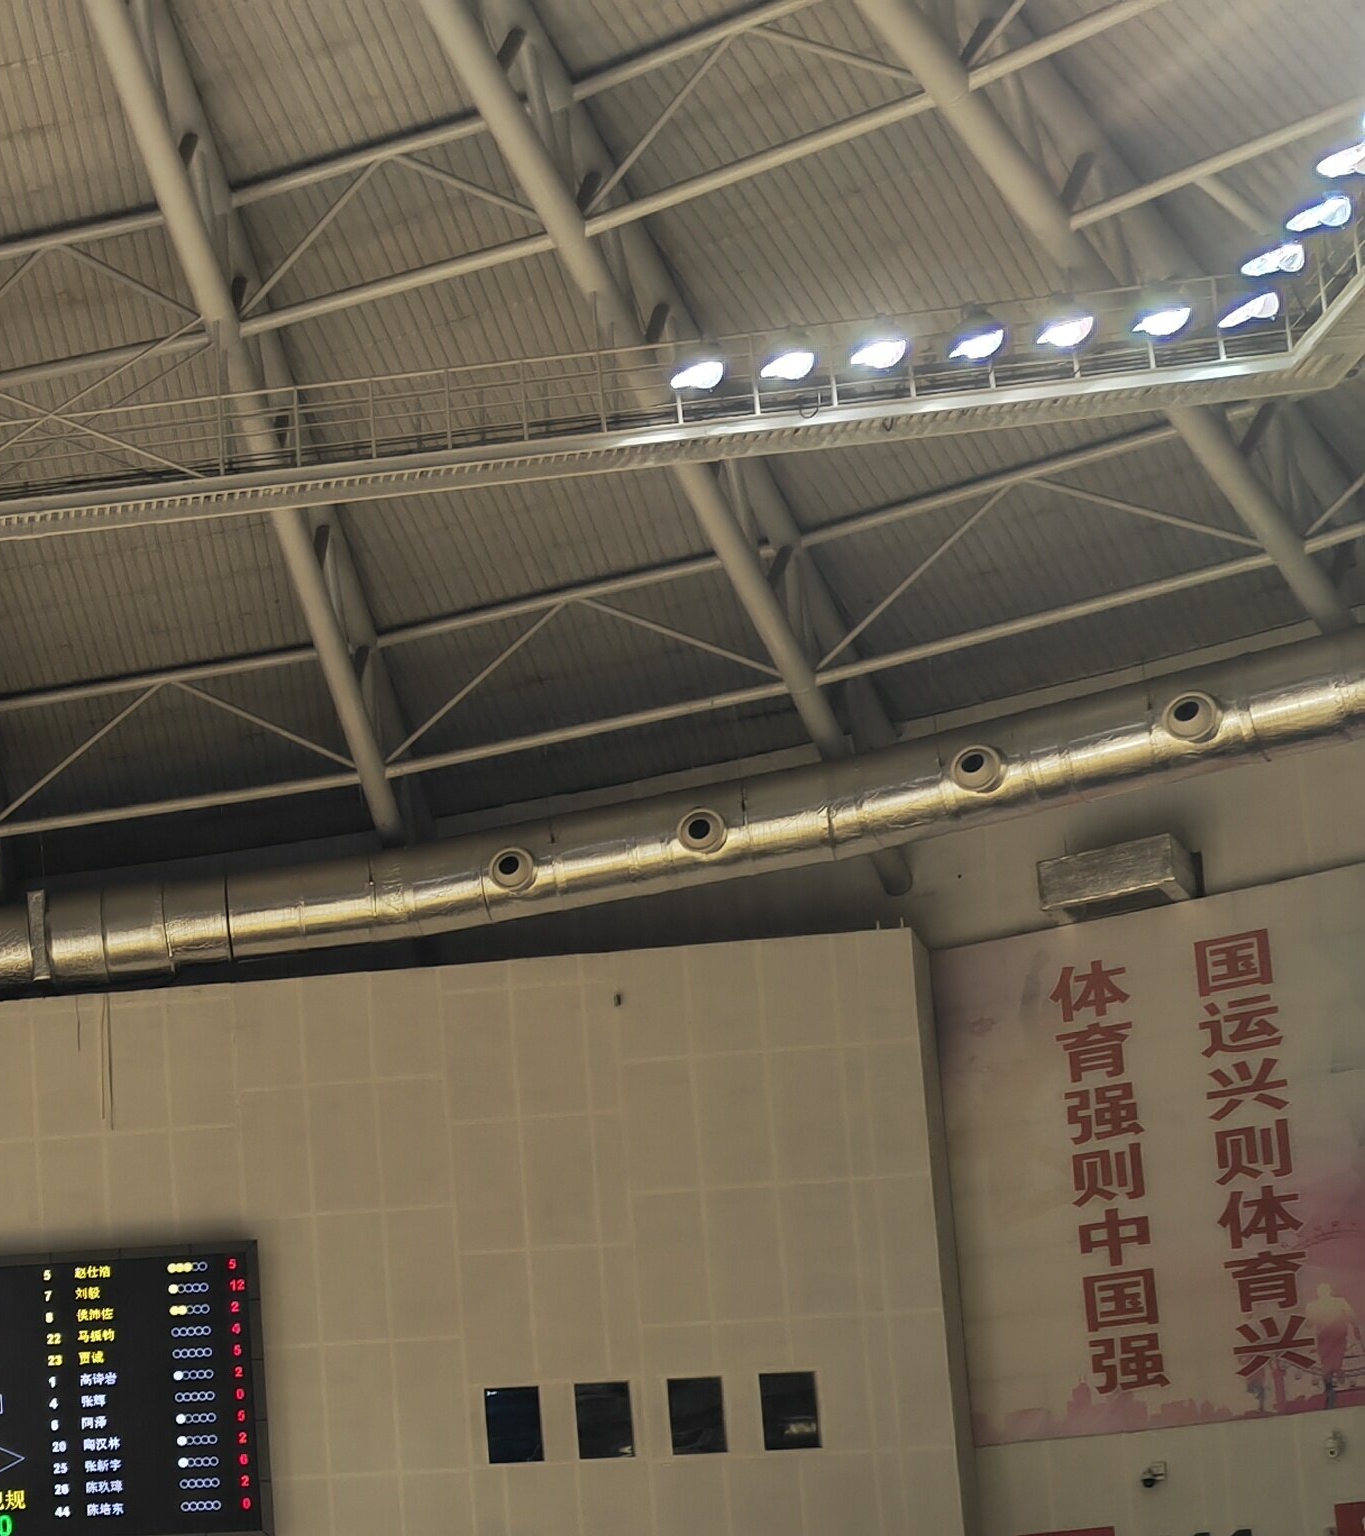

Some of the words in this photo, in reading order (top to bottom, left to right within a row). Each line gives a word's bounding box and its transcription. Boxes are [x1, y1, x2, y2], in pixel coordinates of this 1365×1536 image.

[1194, 928, 1316, 1378] 国运兴则体育兴
[1049, 959, 1170, 1396] 体育强则中国强
[43, 1269, 52, 1281] 5
[44, 1290, 53, 1302] 7
[46, 1333, 62, 1345] 22
[48, 1354, 63, 1366] 23
[48, 1376, 57, 1389] 1
[49, 1398, 58, 1410] 4
[53, 1463, 68, 1475] 25
[54, 1506, 71, 1518] 44
